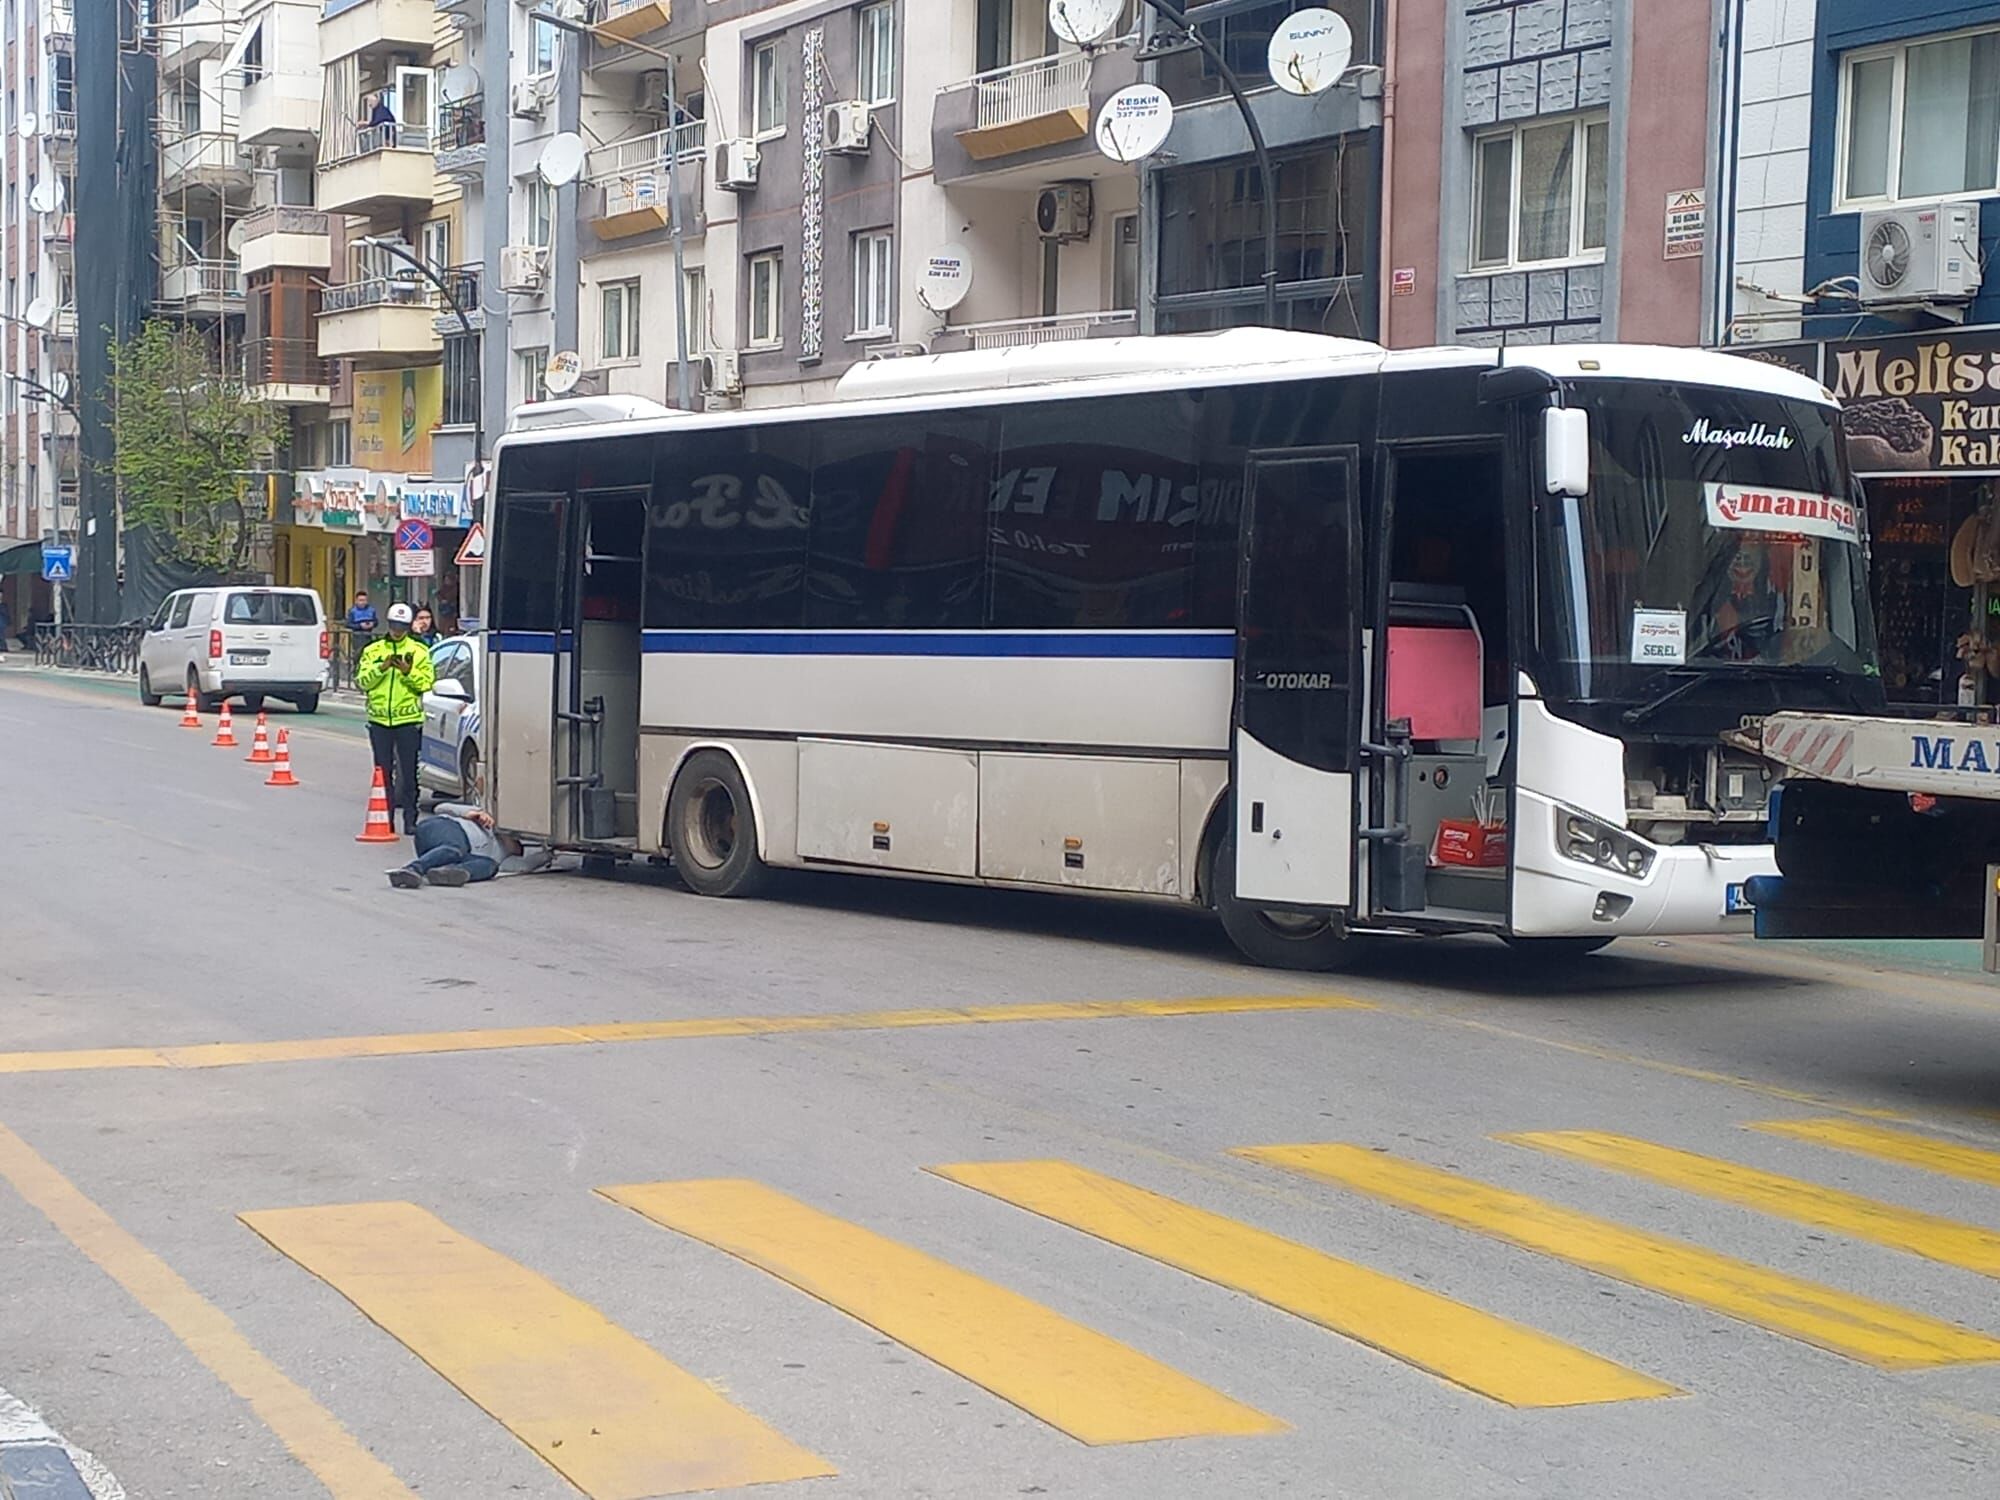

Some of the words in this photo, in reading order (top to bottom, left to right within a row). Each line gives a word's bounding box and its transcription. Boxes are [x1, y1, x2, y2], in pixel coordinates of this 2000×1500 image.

[1289, 26, 1333, 39] SUNNY
[1682, 418, 1794, 449] Maşallah
[1739, 493, 1855, 526] manisa
[1643, 643, 1677, 657] SEREL
[1266, 673, 1331, 689] OTOKAR
